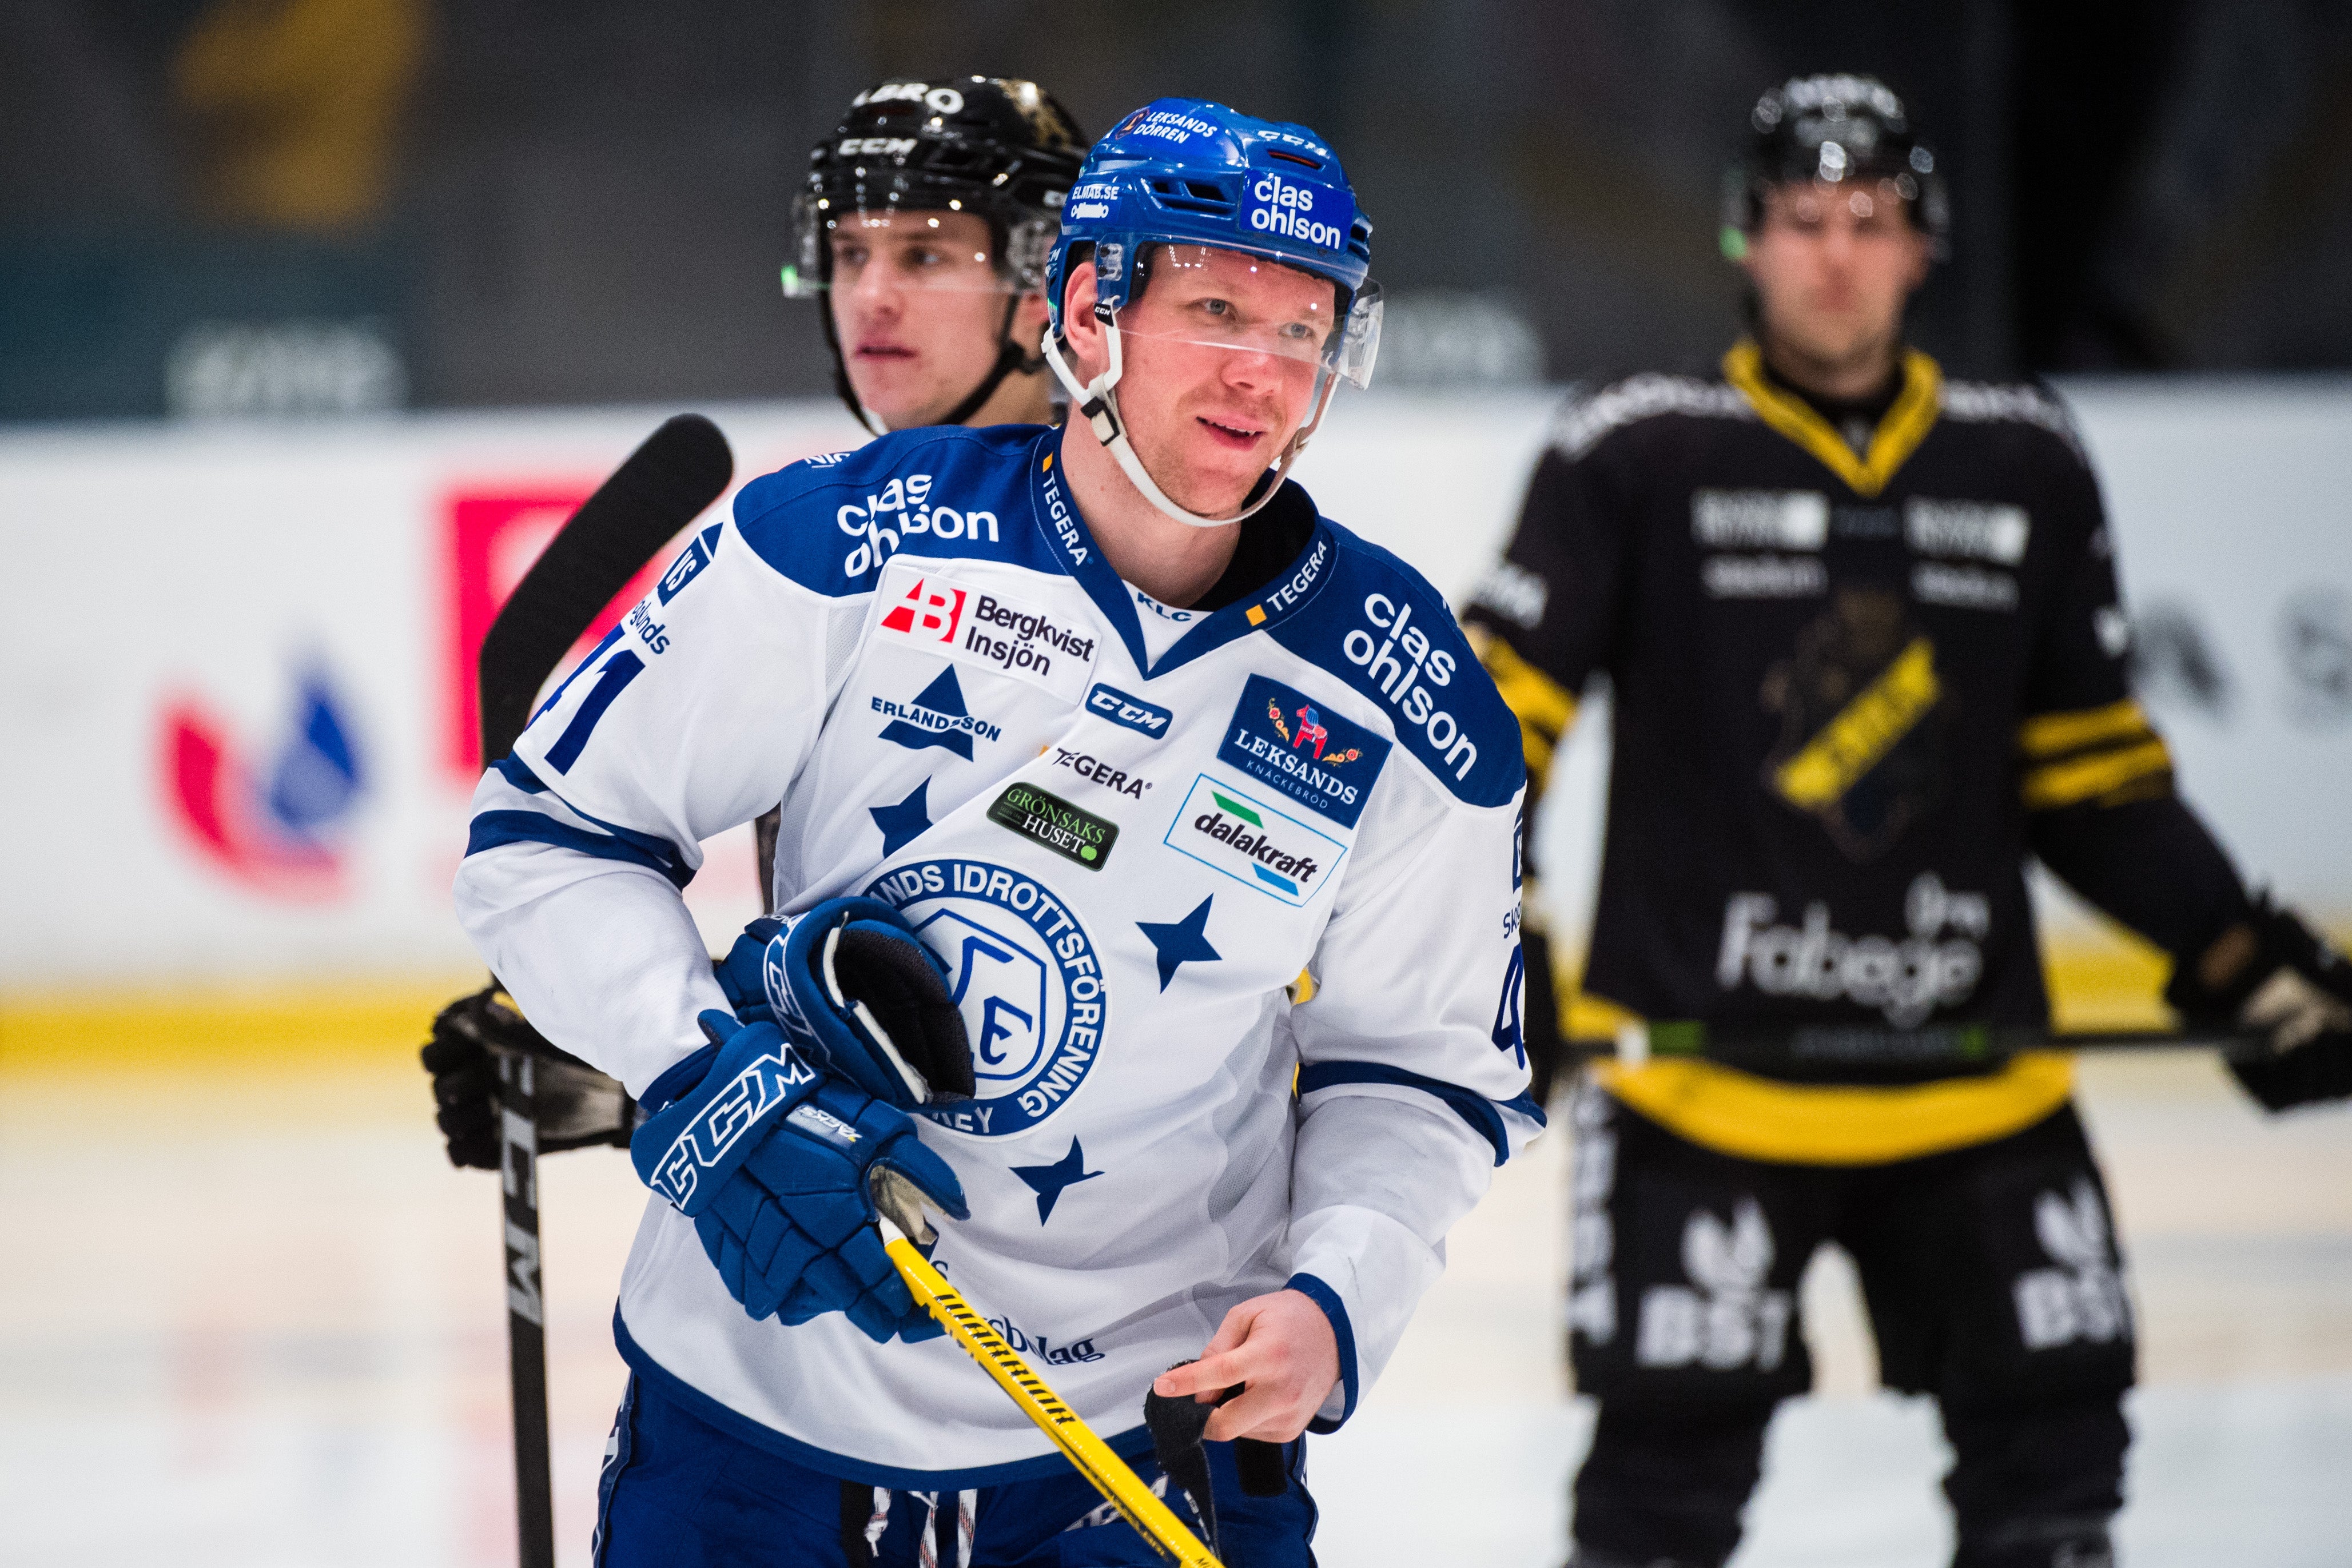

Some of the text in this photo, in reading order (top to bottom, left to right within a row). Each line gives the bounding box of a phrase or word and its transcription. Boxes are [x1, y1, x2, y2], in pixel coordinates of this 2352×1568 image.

[838, 138, 918, 156] CCM
[1133, 122, 1190, 144] DÖRREN
[1145, 112, 1217, 138] LEKSANDS
[1072, 185, 1120, 200] ELMAB.SE
[1254, 176, 1314, 212] clas
[1251, 206, 1341, 249] ohlson
[1095, 306, 1111, 316] CCM
[837, 474, 932, 537] clas
[1042, 470, 1089, 566] TEGERA
[844, 503, 1000, 578] ohlson
[1266, 540, 1327, 612] TEGERA
[974, 595, 1095, 662] Bergkvist
[1137, 592, 1192, 622] KLC
[965, 626, 1050, 676] Insjön
[1364, 593, 1456, 686] clas
[1092, 690, 1168, 731] CCM
[1343, 630, 1477, 781] ohlson
[1235, 729, 1359, 806] LEKSANDS
[1246, 759, 1328, 809] KNÄCKEBRÖD
[1007, 789, 1105, 844] GRÖNSAKS
[1022, 813, 1086, 853] HUSET
[1194, 812, 1318, 883] dalakraft
[650, 1042, 815, 1211] CCM
